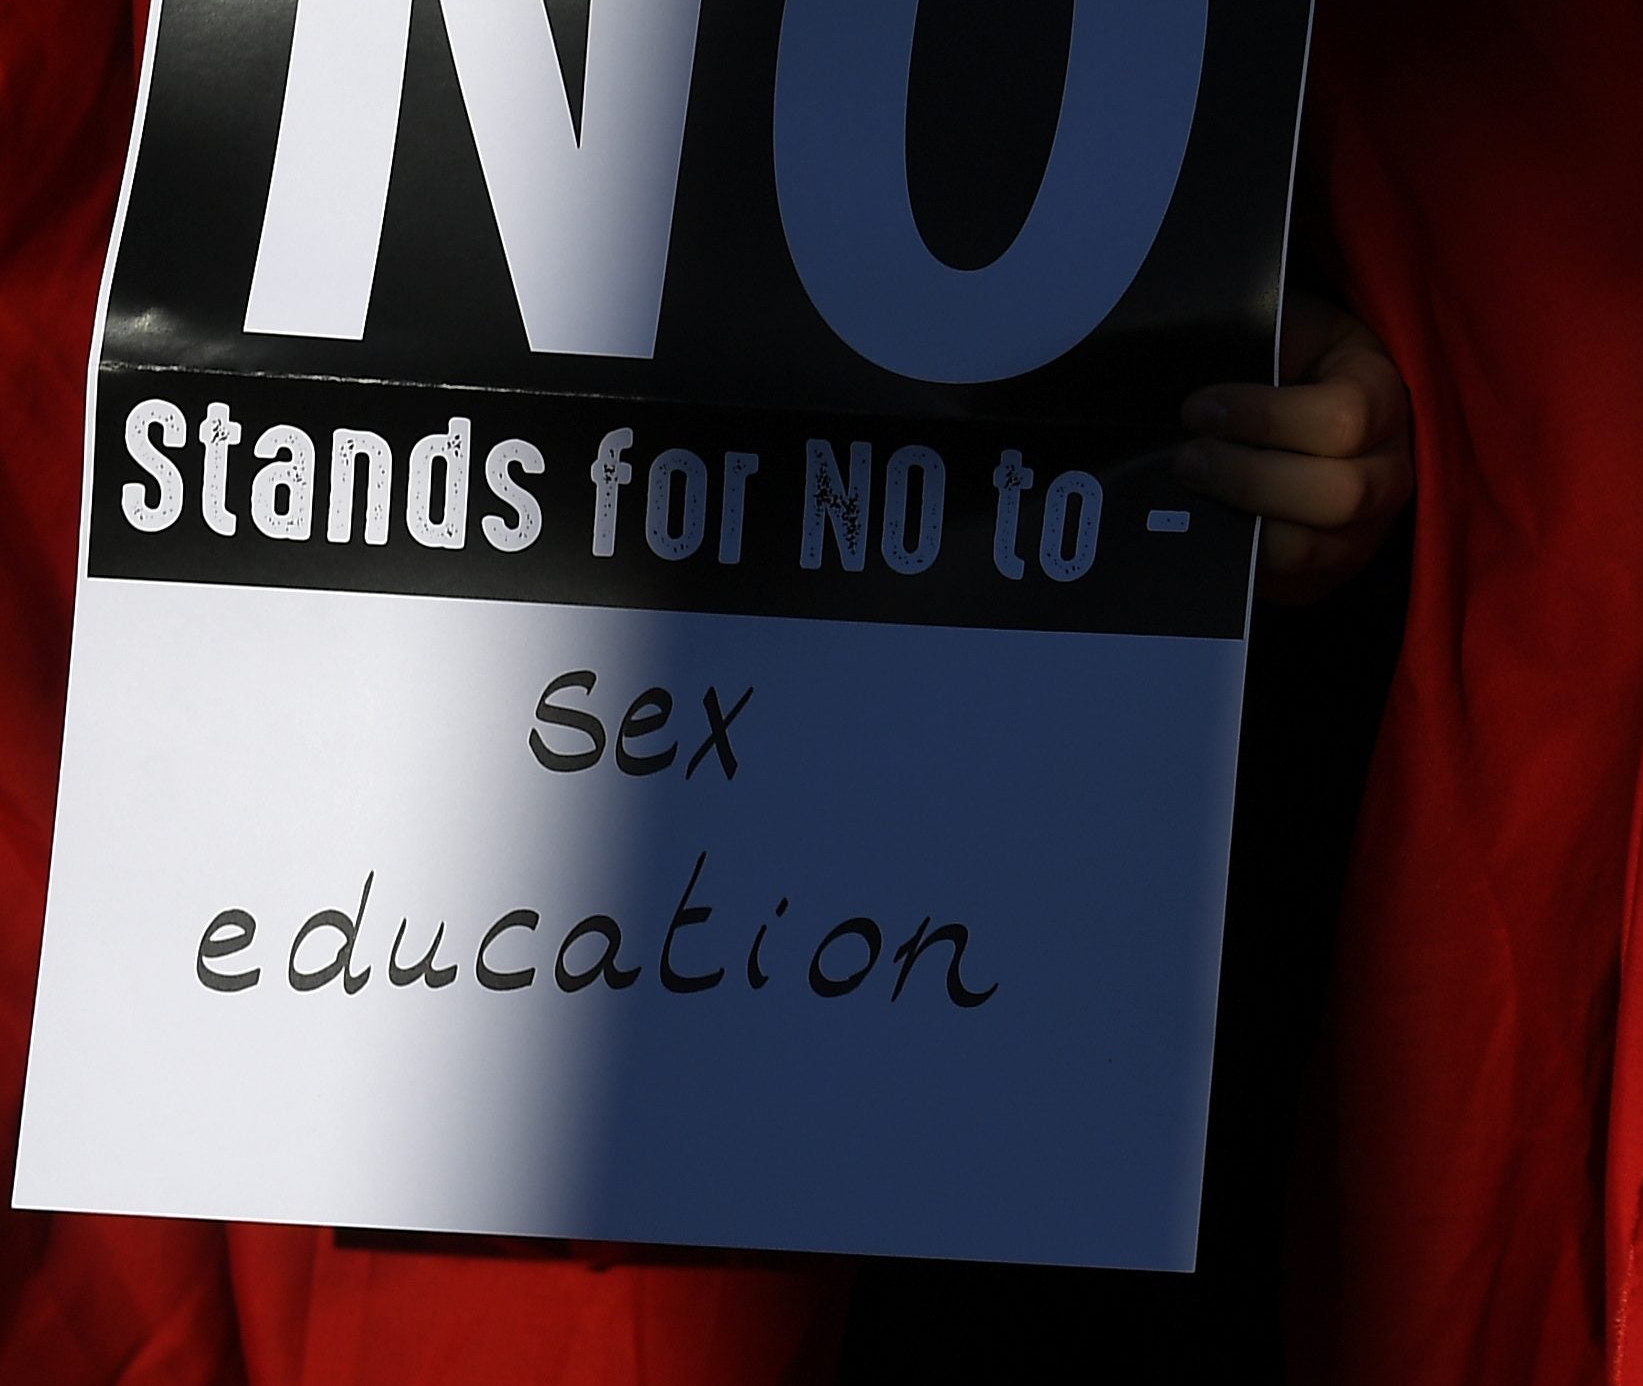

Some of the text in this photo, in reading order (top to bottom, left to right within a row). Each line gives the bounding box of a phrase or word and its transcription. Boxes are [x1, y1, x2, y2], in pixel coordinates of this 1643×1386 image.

[121, 398, 545, 552] Stands
[590, 427, 759, 564] for
[799, 438, 946, 575] NO
[993, 449, 1102, 582] to
[197, 852, 999, 1008] education
